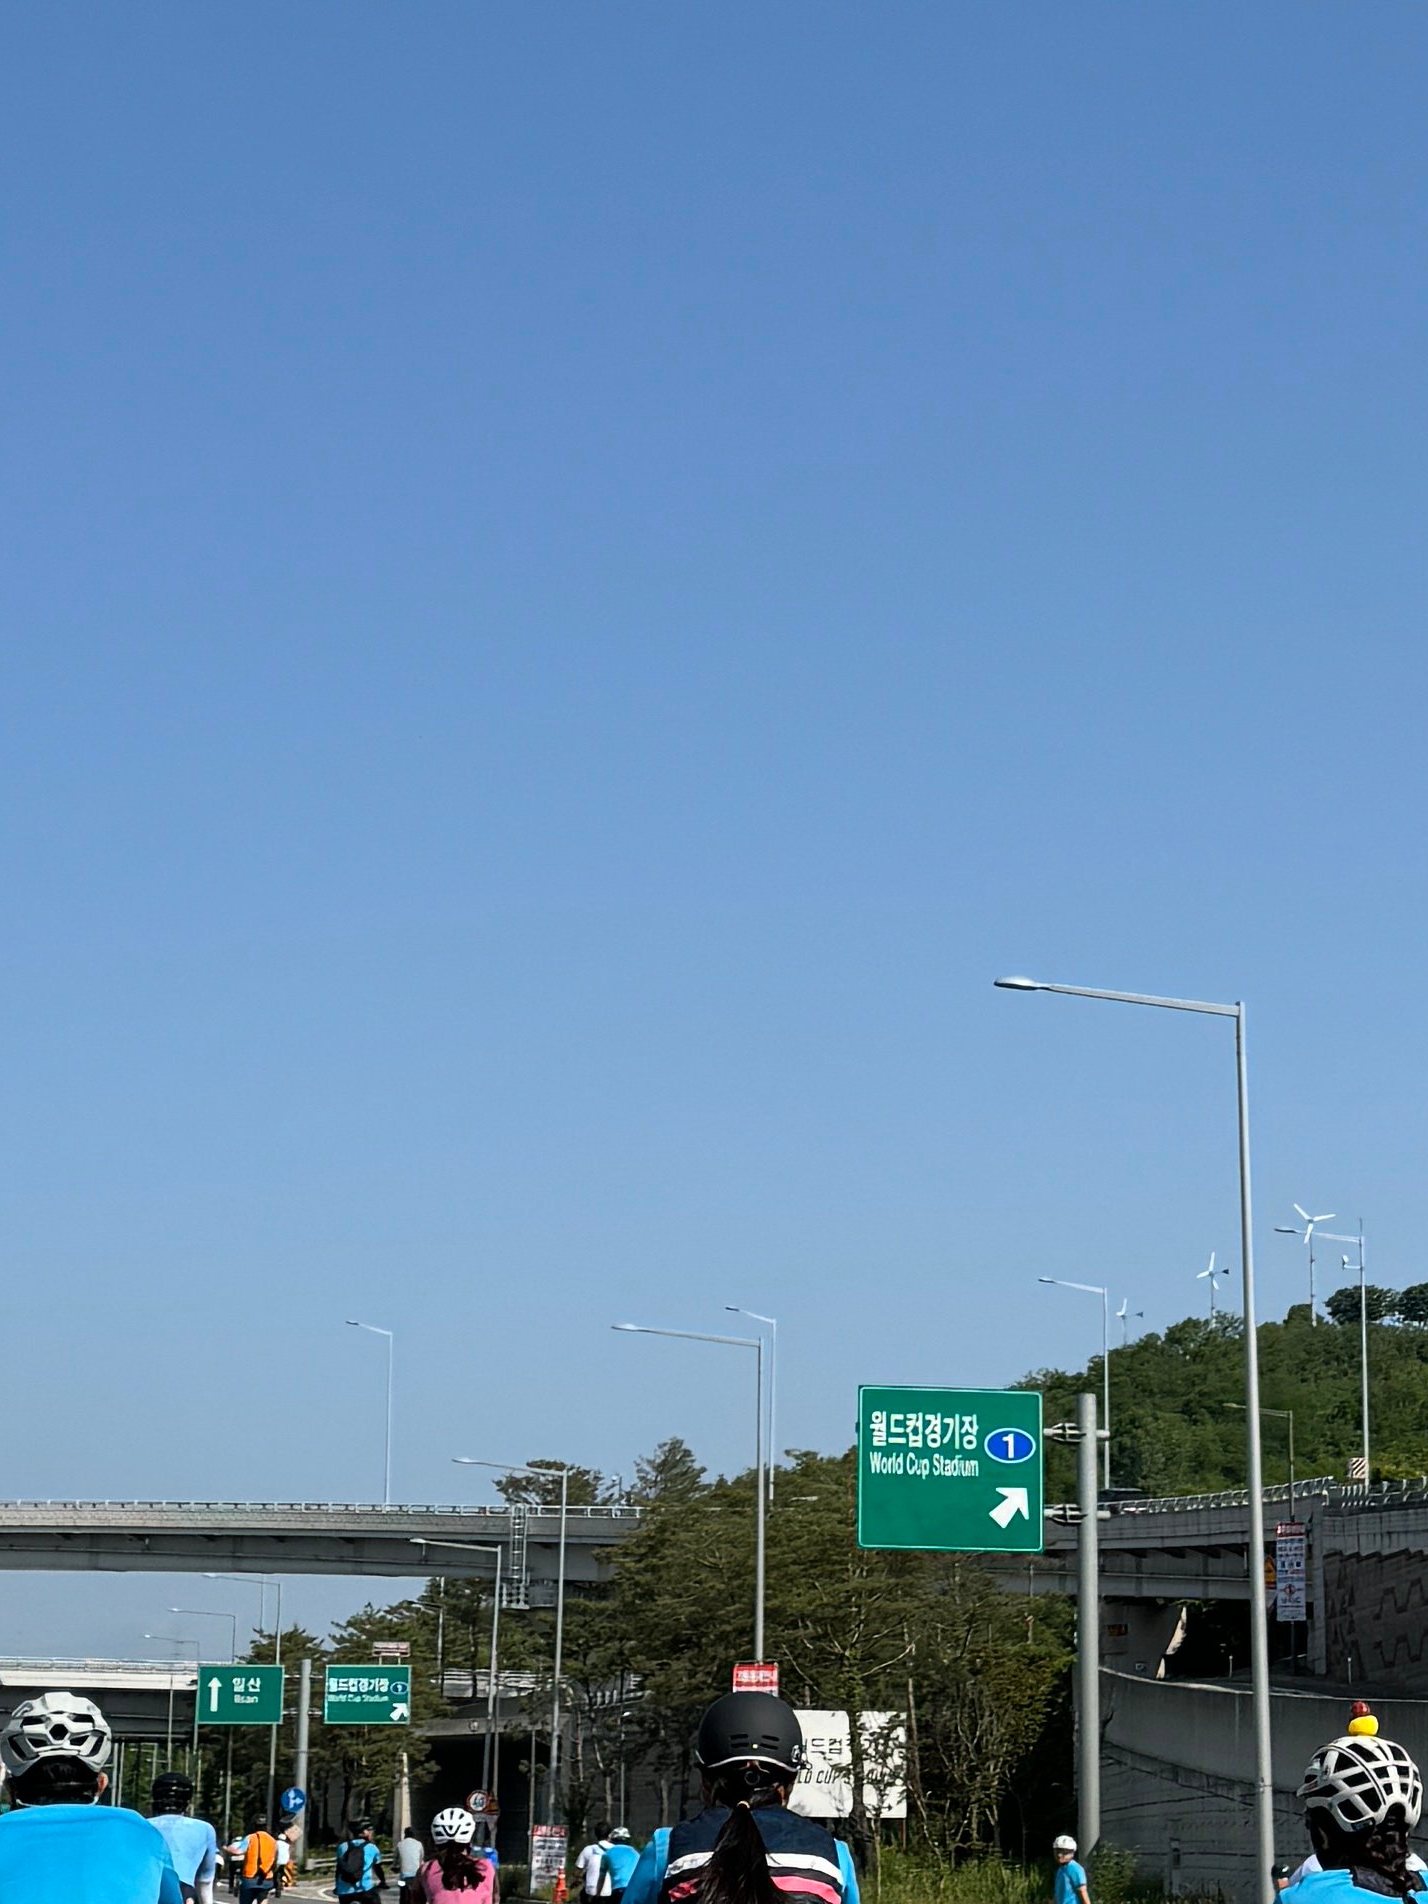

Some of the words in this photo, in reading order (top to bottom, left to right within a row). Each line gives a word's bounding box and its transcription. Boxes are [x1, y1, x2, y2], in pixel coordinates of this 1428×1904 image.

[869, 1411, 979, 1450] 월드컵경기장
[1001, 1433, 1015, 1459] 1
[869, 1451, 904, 1475] World
[906, 1452, 930, 1480] Cup
[932, 1453, 979, 1477] Stadium
[232, 1677, 261, 1693] 일산
